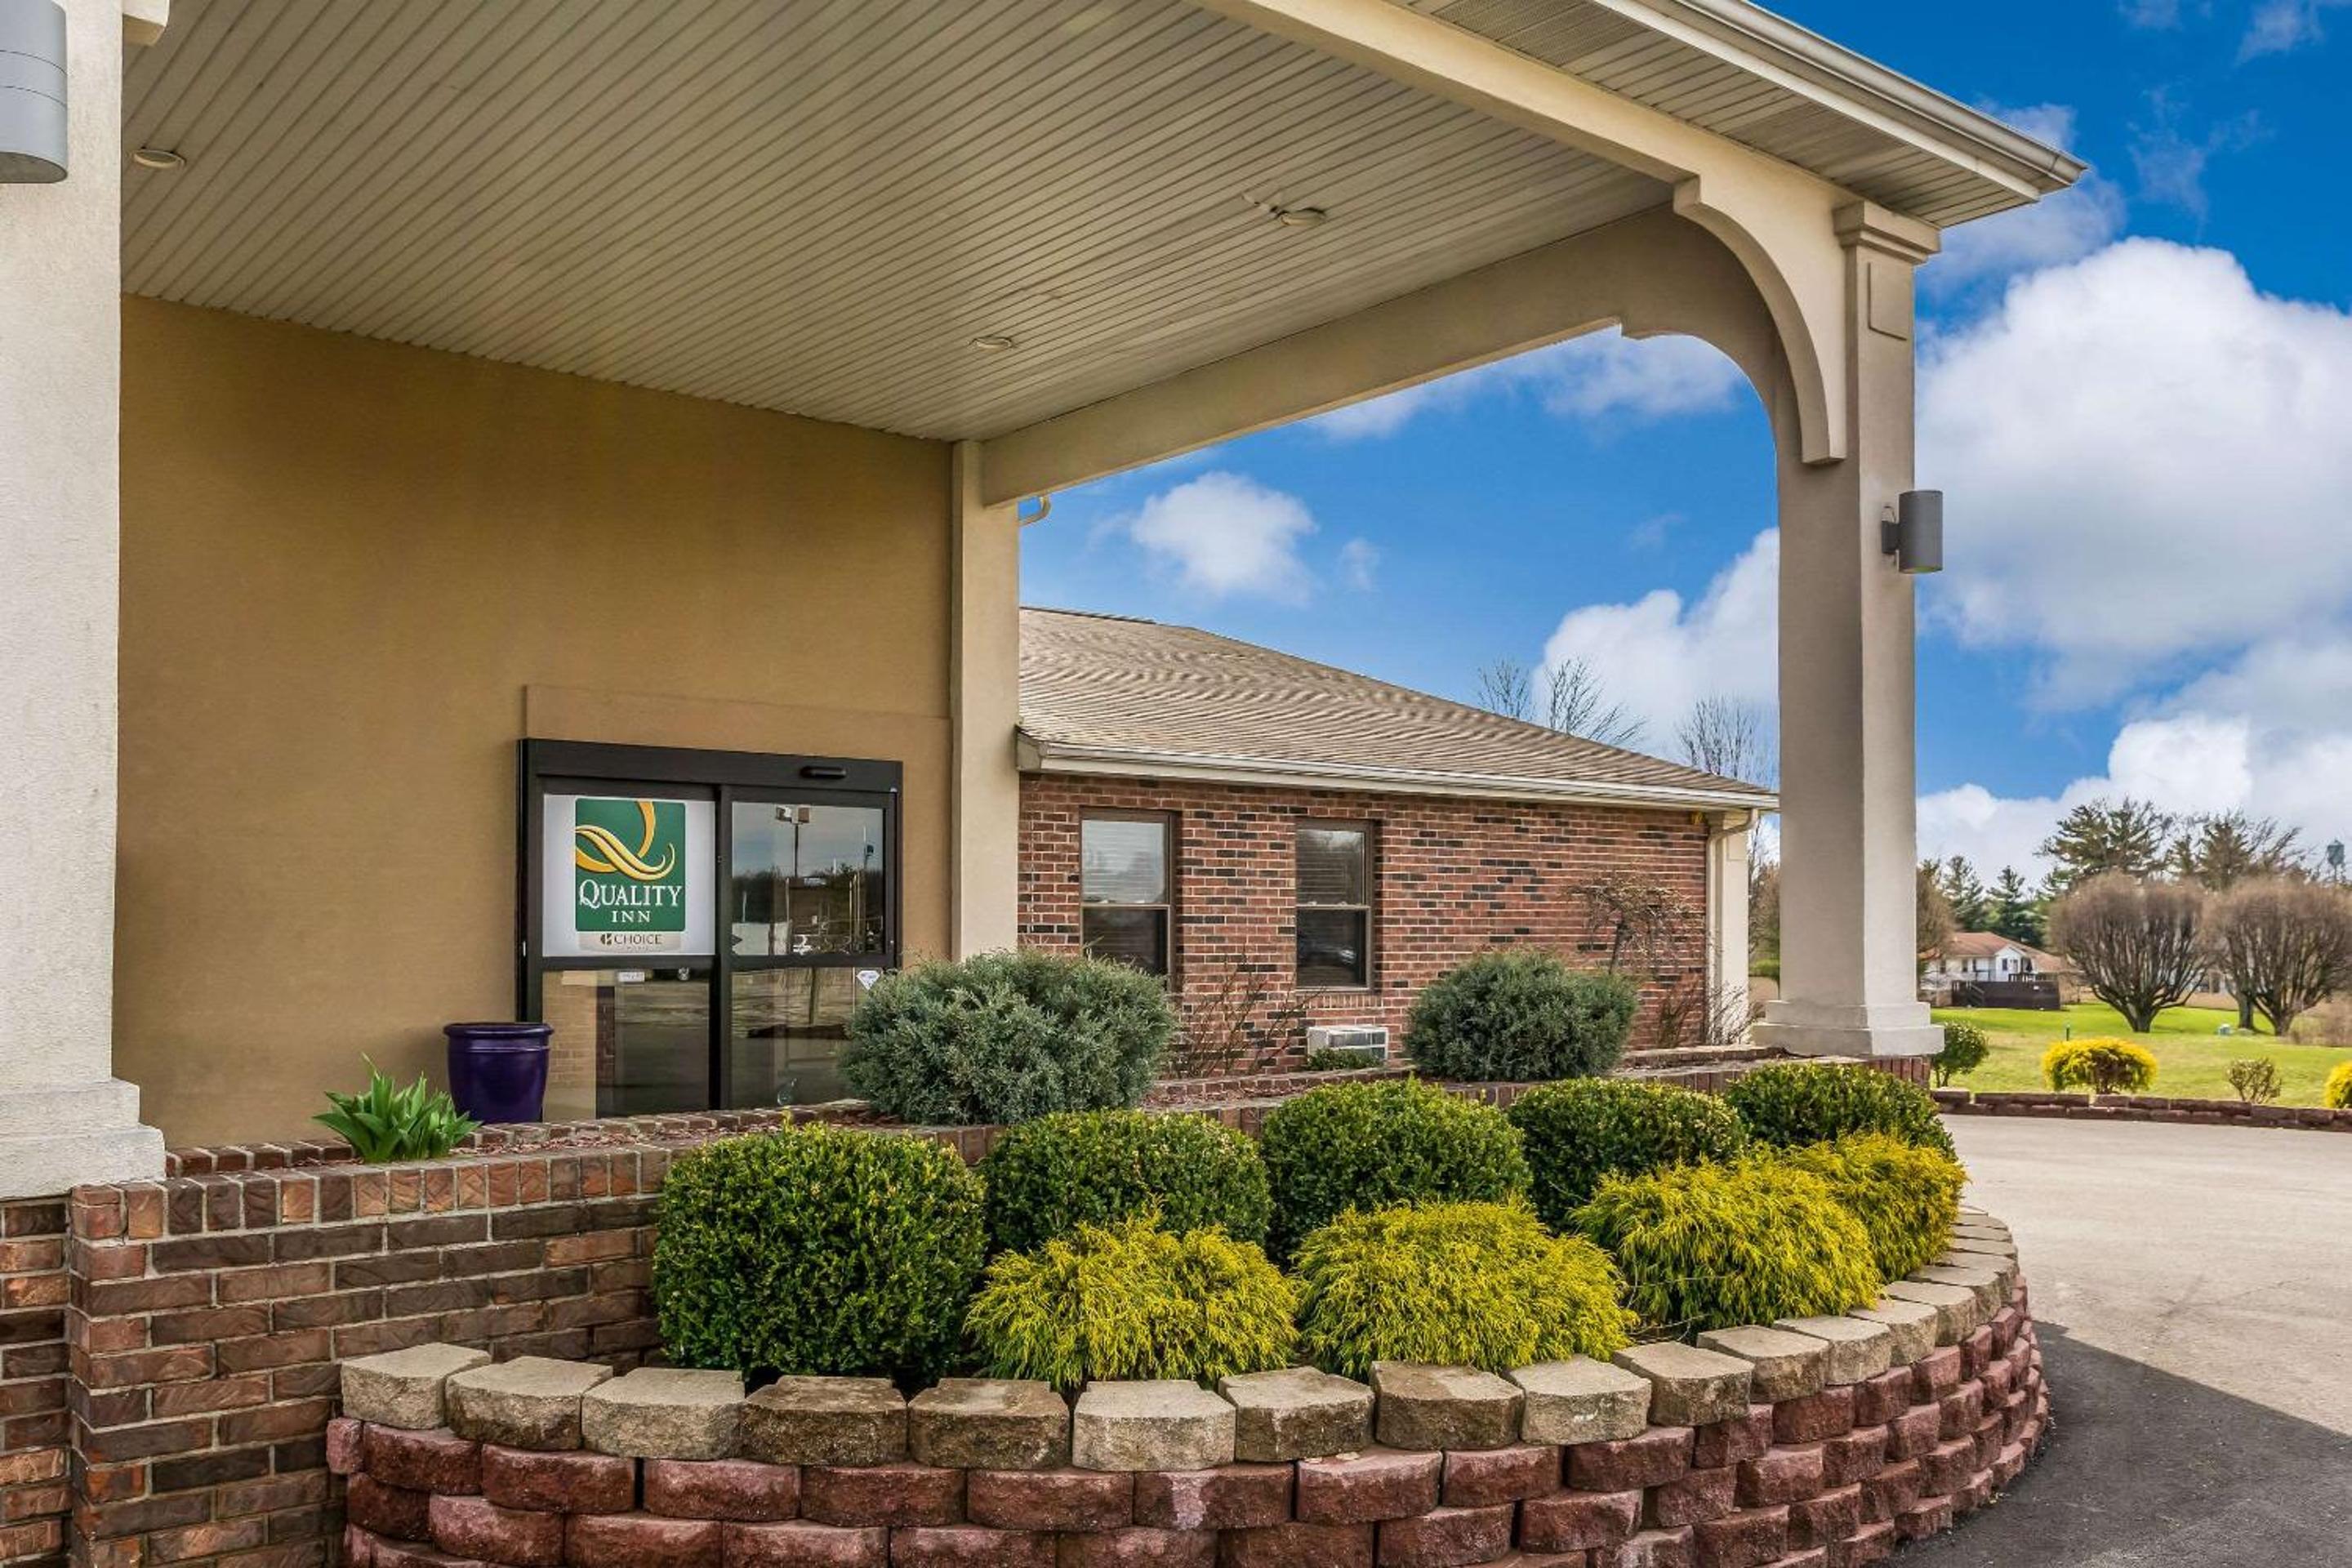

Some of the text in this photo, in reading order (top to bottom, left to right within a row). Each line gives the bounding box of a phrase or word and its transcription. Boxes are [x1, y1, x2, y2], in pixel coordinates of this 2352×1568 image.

[579, 879, 682, 909] QUALITY
[612, 910, 650, 923] INN
[614, 933, 663, 944] CHOICE
